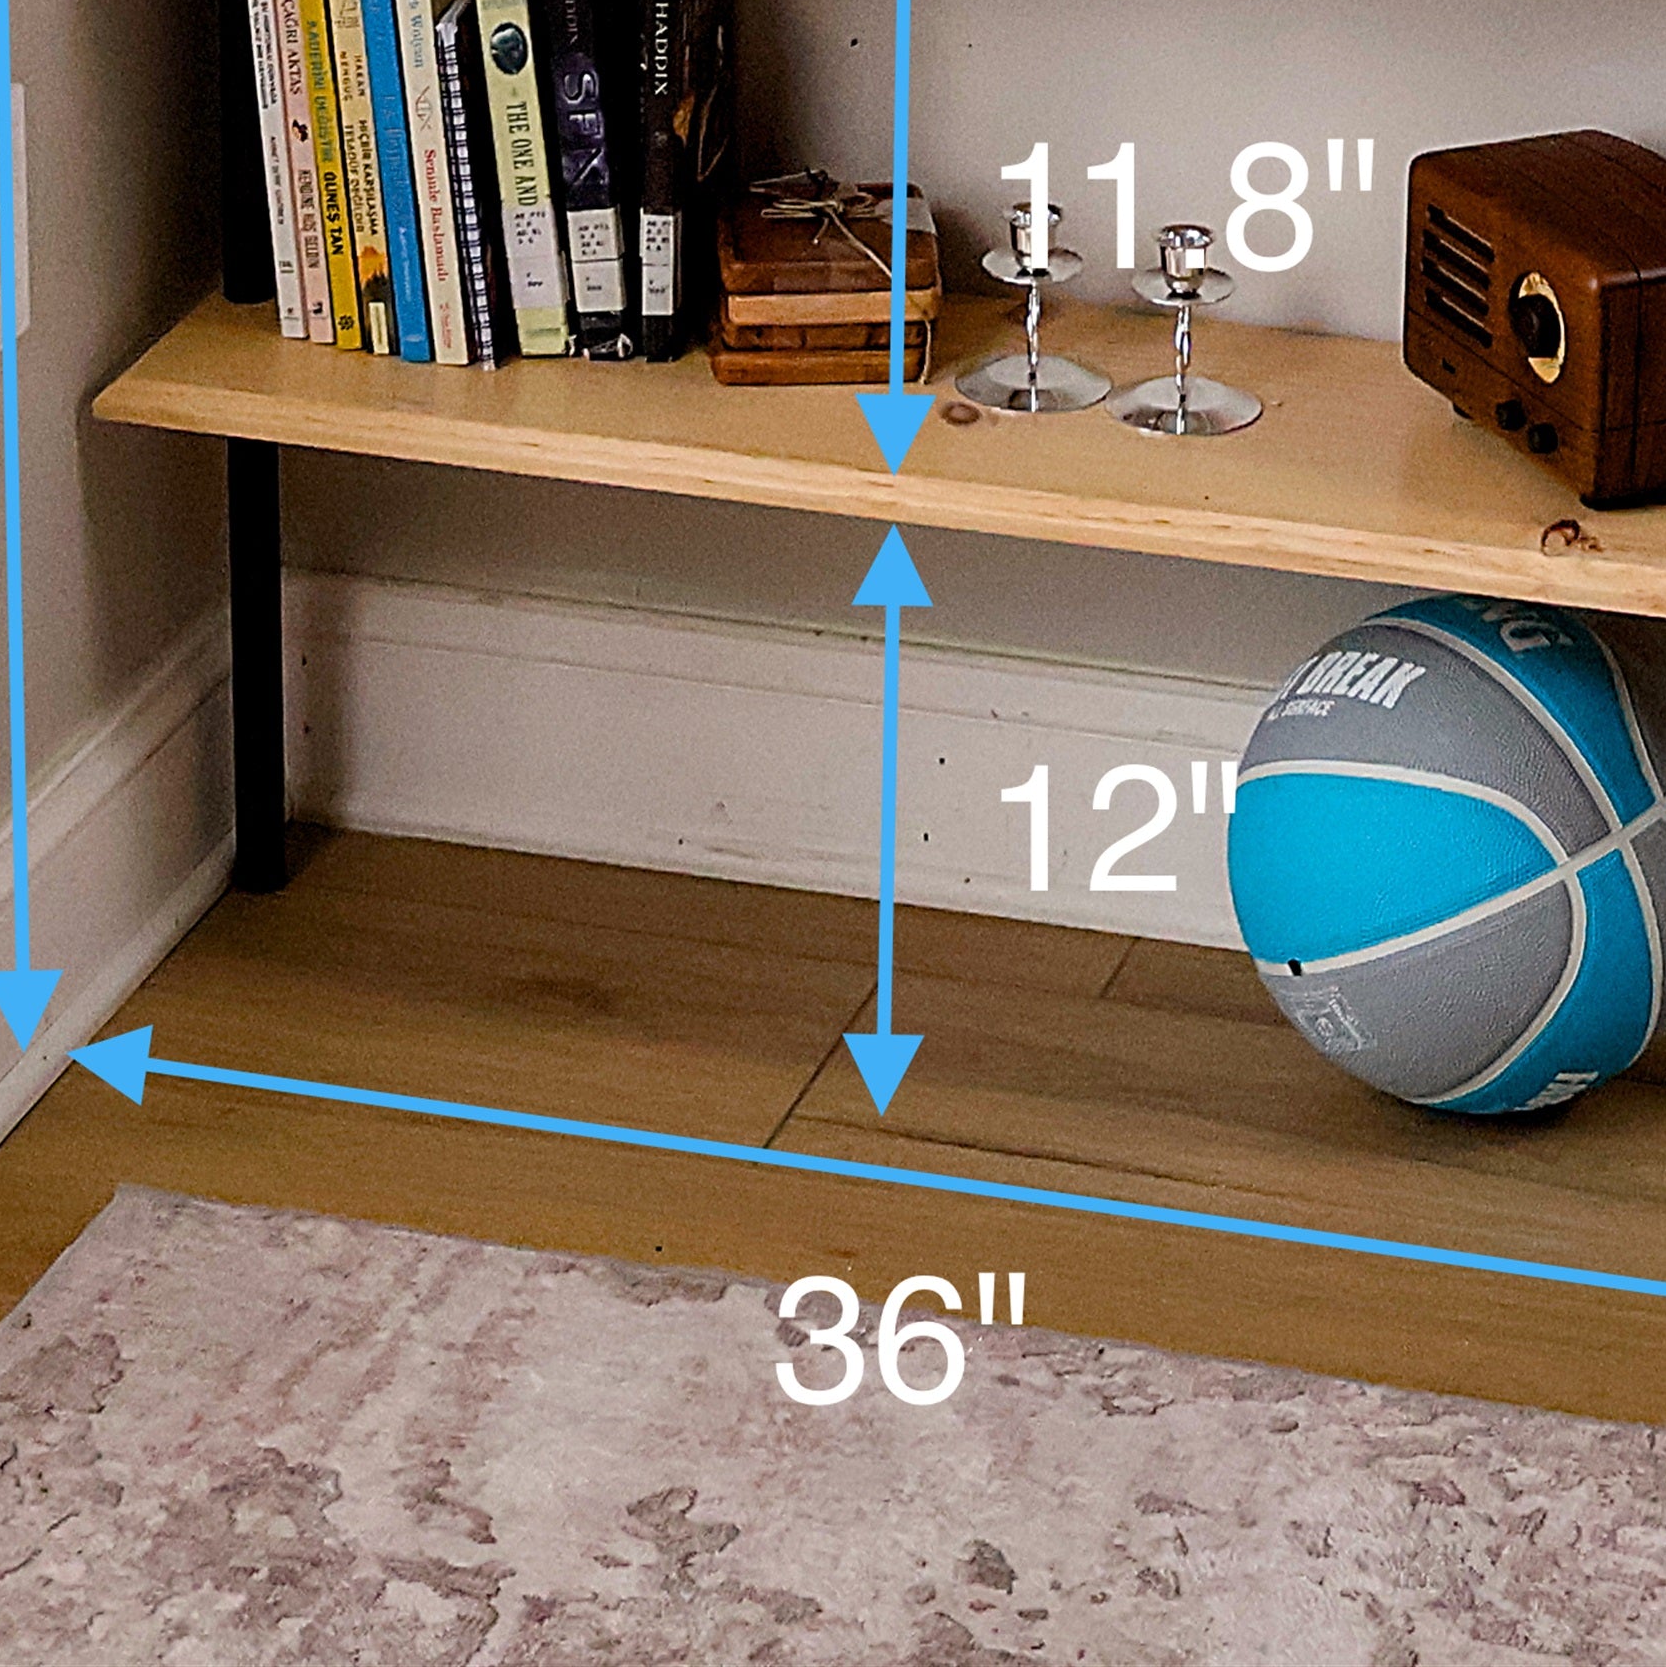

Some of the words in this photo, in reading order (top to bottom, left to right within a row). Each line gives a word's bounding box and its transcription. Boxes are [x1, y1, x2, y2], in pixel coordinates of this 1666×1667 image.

[654, 2, 670, 96] HADDIX
[506, 101, 530, 134] THE
[511, 139, 534, 170] ONE
[515, 175, 539, 206] AND
[330, 227, 344, 255] TAN
[1295, 650, 1427, 710] BREAK
